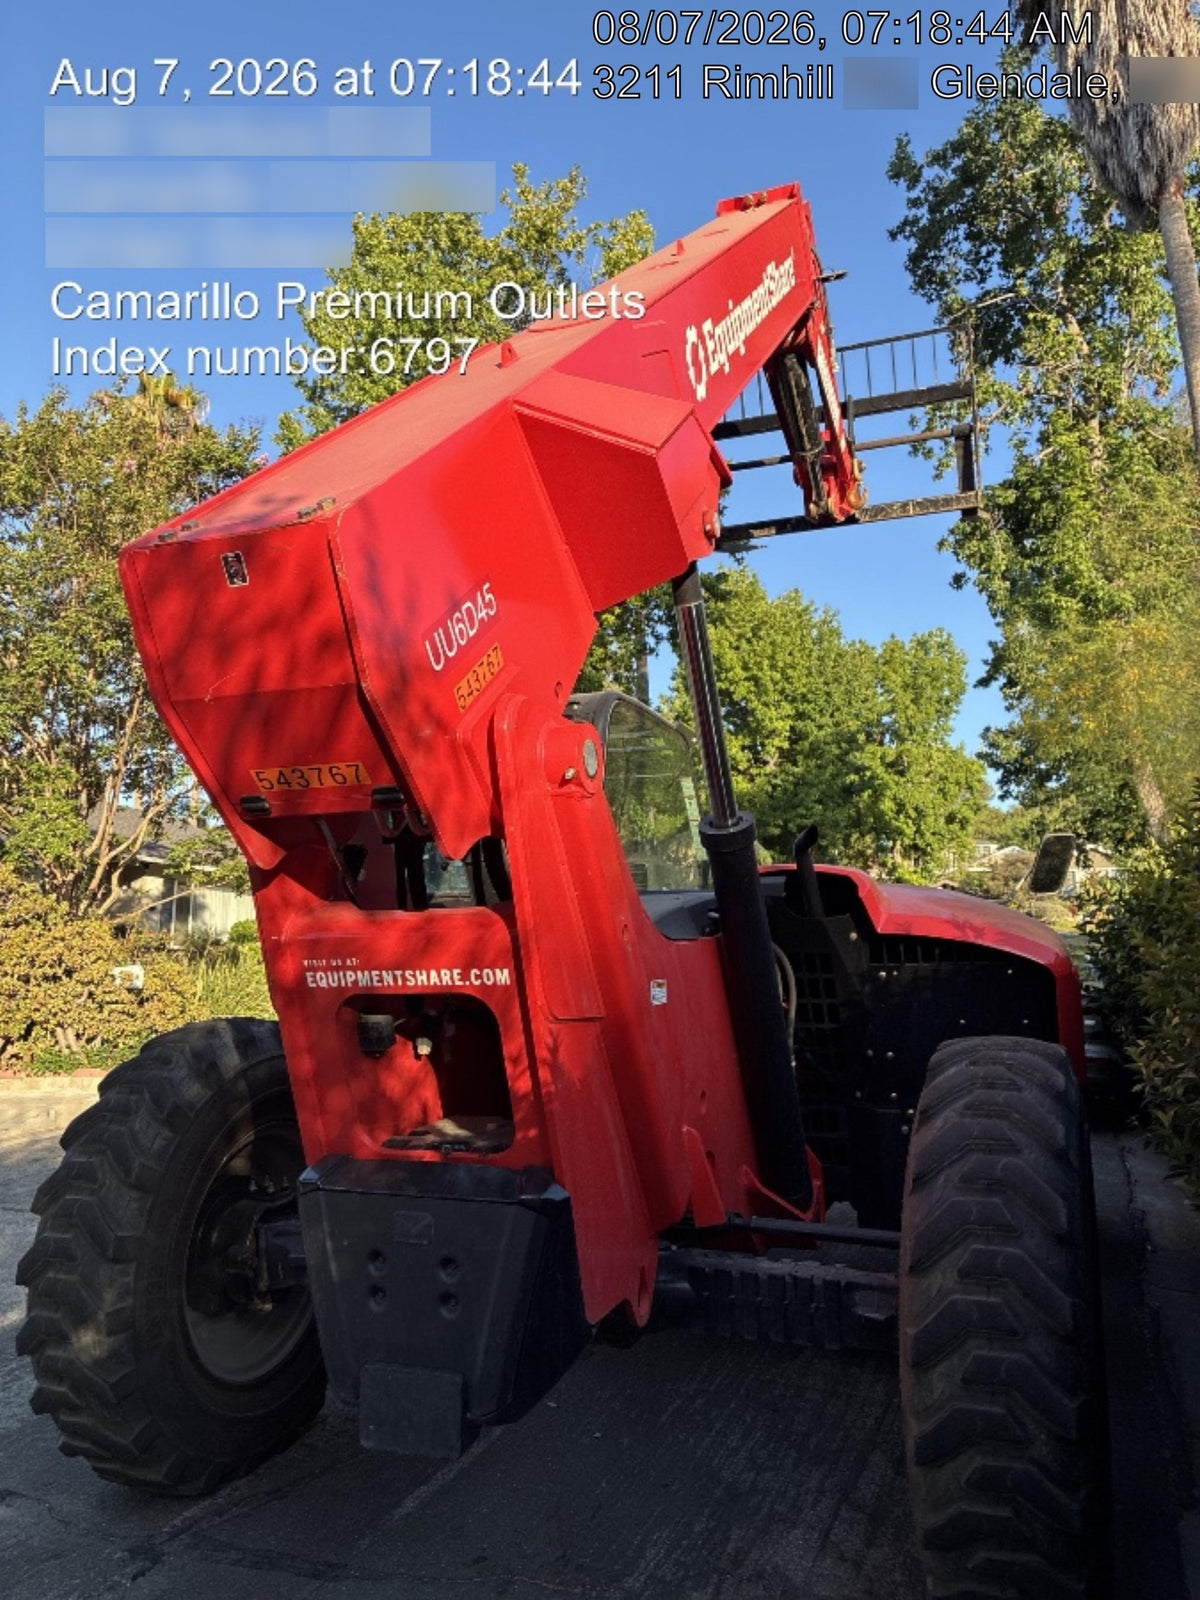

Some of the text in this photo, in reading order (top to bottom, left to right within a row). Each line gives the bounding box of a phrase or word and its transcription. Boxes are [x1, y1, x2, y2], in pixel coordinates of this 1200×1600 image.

[424, 581, 498, 672] UU6D45
[254, 763, 363, 791] 543767
[305, 968, 511, 988] EQUIPMENTSHARE.COM
